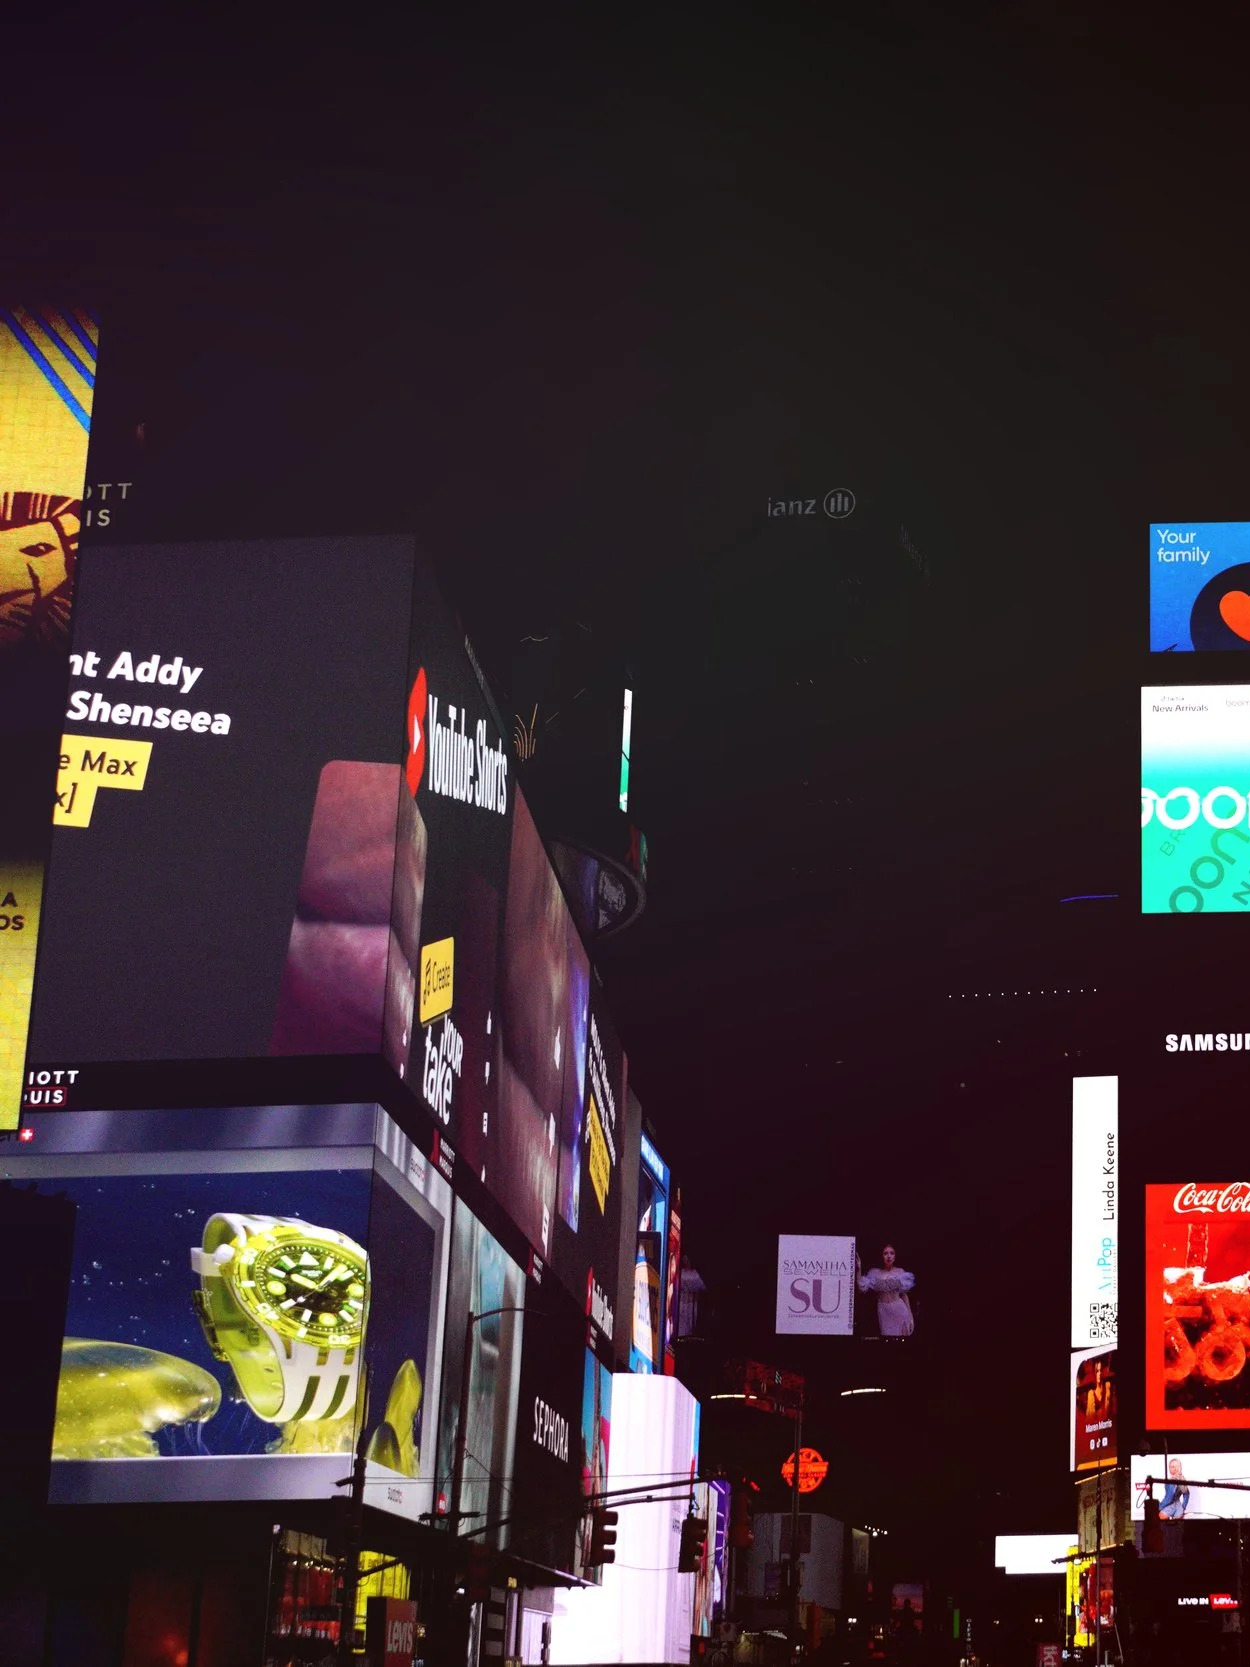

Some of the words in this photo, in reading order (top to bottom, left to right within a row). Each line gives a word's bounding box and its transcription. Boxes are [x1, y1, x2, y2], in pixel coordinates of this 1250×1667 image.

[1156, 529, 1197, 544] Your
[1156, 546, 1211, 566] family
[107, 651, 204, 693] Addy
[66, 691, 232, 735] Shenseea
[1152, 704, 1173, 713] New
[1174, 703, 1209, 713] Arrivals
[80, 749, 137, 777] Max
[428, 693, 475, 805] YouTube
[475, 718, 508, 816] Shorts
[432, 961, 451, 993] Create
[422, 1024, 453, 1126] take
[1102, 1132, 1115, 1175] Keene
[1102, 1180, 1115, 1221] Linda
[783, 1260, 848, 1271] SAMANTHA
[783, 1268, 848, 1277] SEWELL
[787, 1277, 841, 1314] SU
[533, 1395, 569, 1463] SEPHORA
